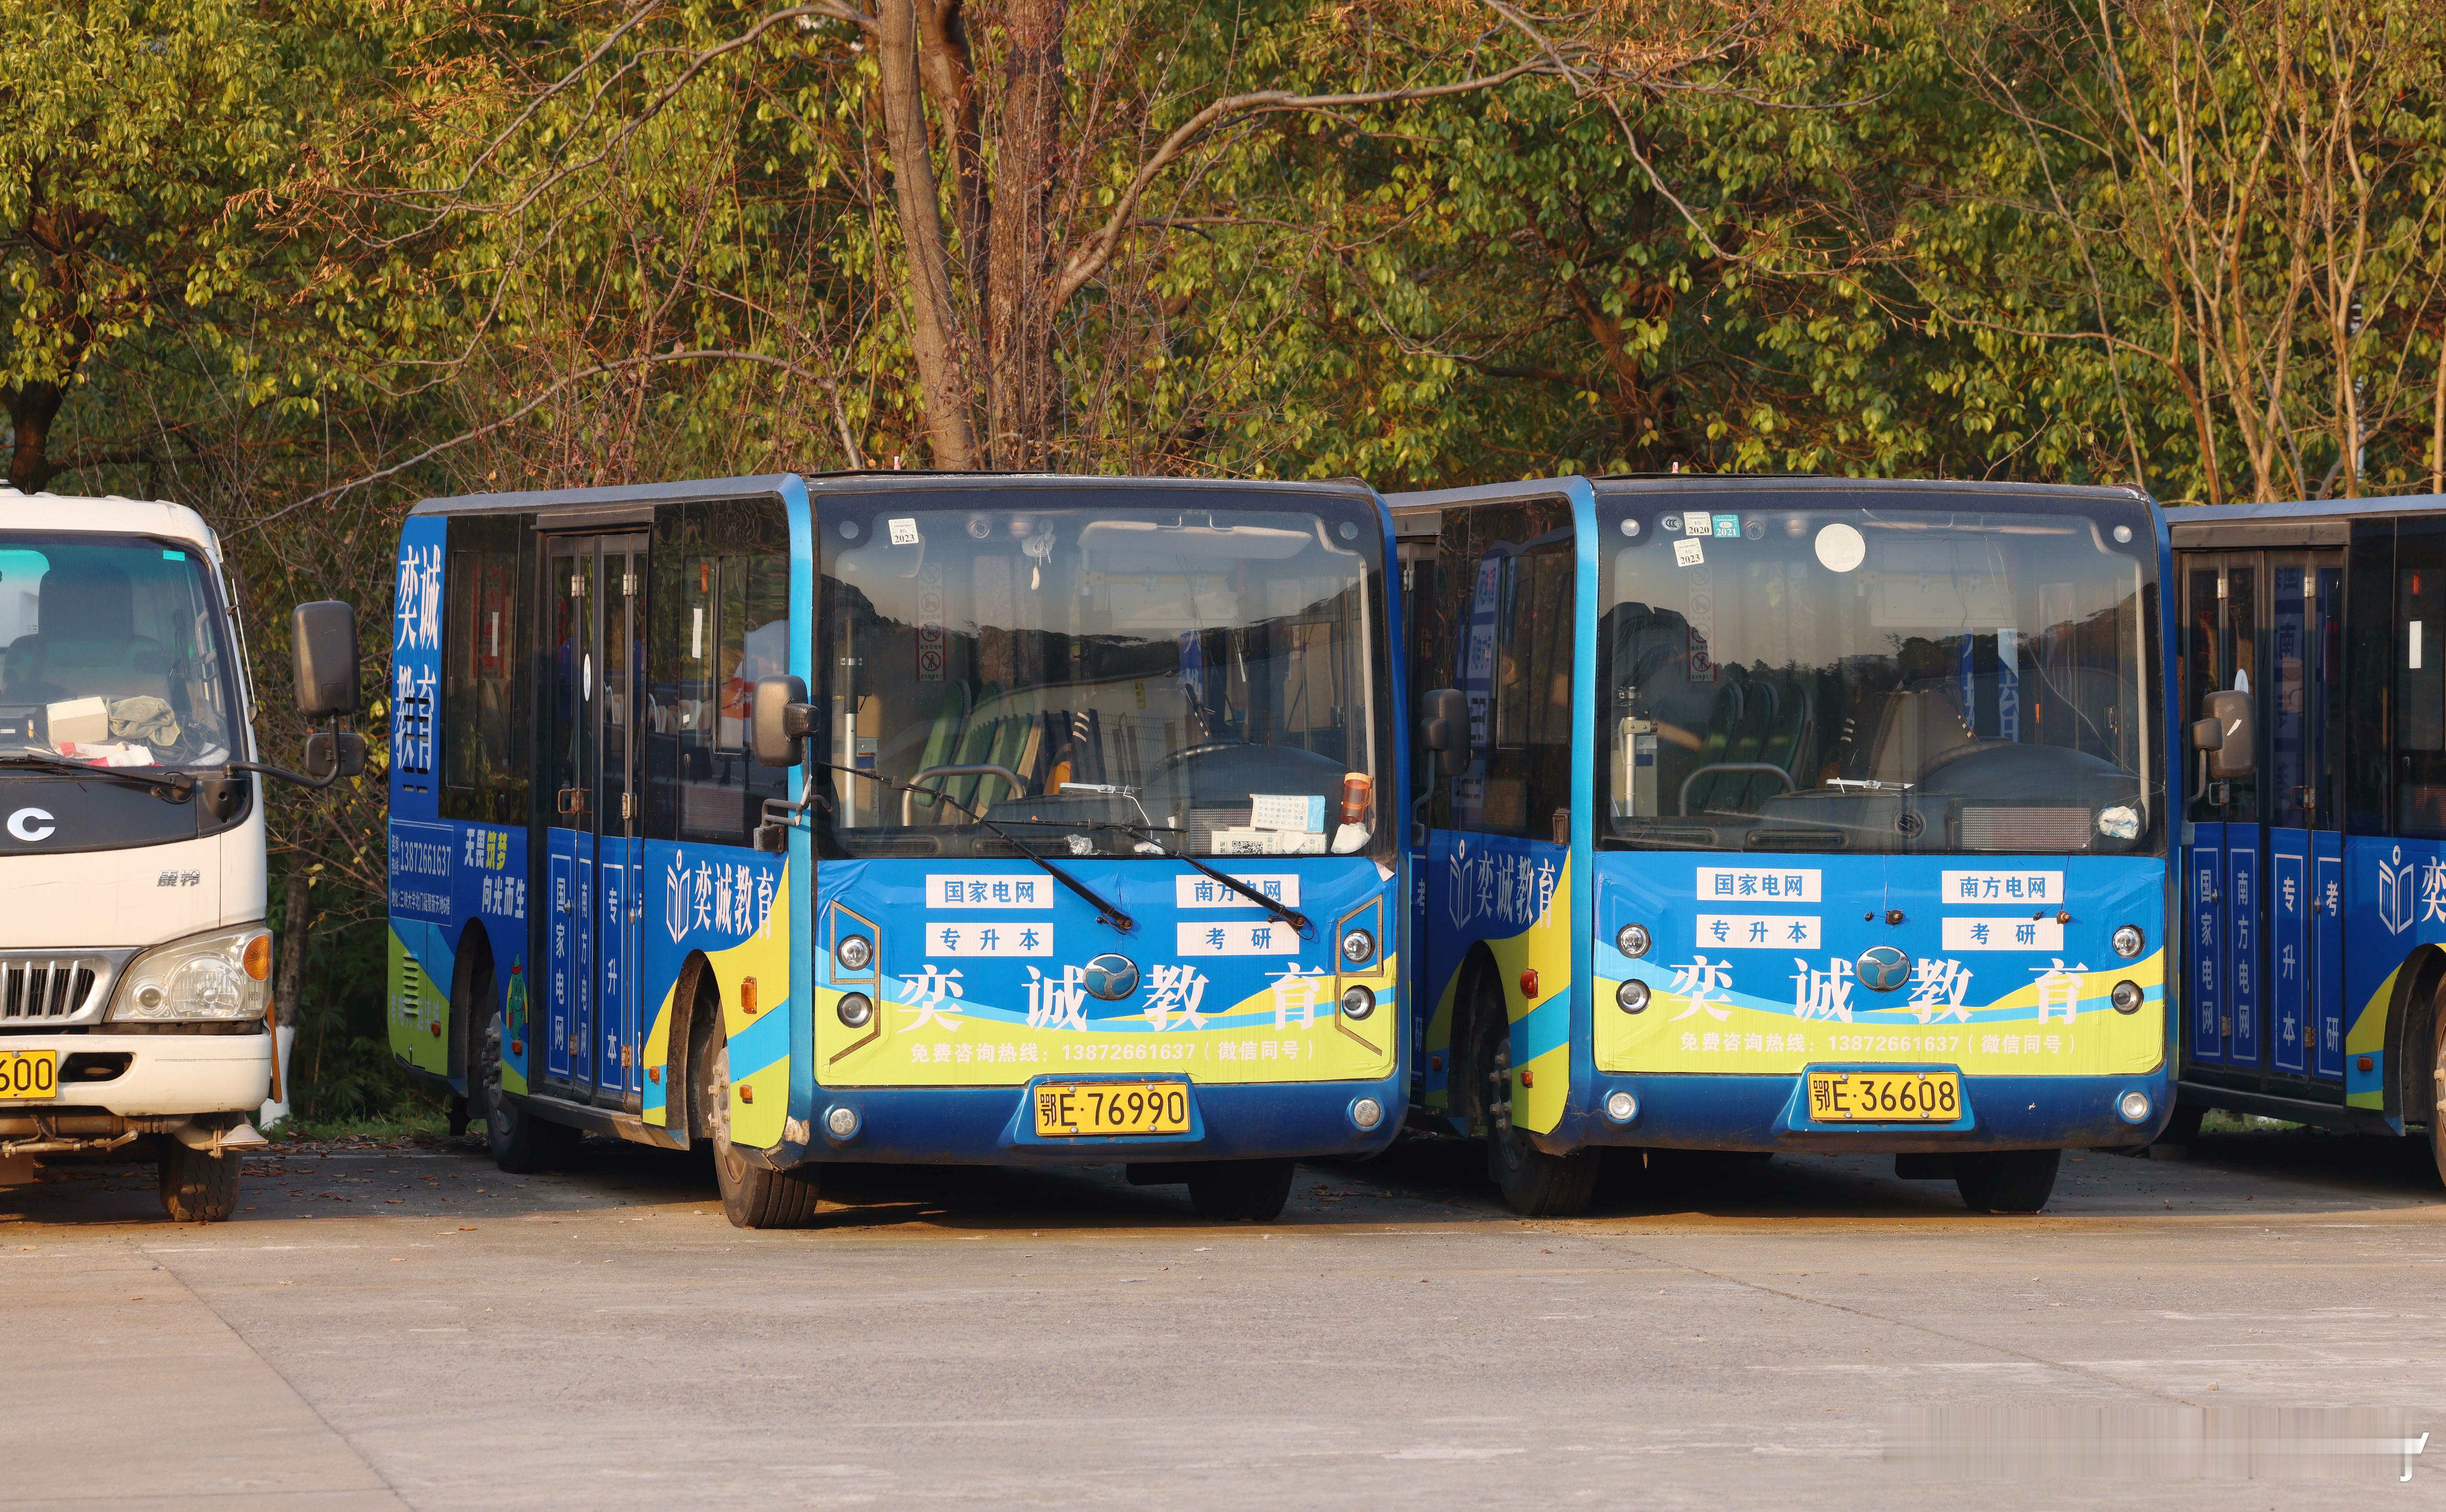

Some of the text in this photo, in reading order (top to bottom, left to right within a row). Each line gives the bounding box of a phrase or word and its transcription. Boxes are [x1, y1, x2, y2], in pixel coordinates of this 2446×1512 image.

[894, 534, 915, 543] 2023
[1716, 528, 1737, 536] 2021
[1680, 554, 1701, 565] 2023
[397, 544, 441, 651] 奕诚
[391, 834, 399, 853] 咨询
[400, 841, 451, 877] 13872661637
[464, 828, 508, 871] 无畏筑梦
[156, 869, 201, 887] 康铃
[944, 880, 1036, 904] 国家电网
[1475, 850, 1555, 930] 奕诚教育
[1714, 873, 1803, 897] 国家电网
[1959, 876, 2047, 899] 南方电网
[482, 874, 525, 919] 向光而生
[694, 860, 774, 940] 奕诚教育
[939, 927, 1040, 951] 专升本
[1205, 927, 1272, 950] 考研
[1710, 919, 1808, 944] 专升本
[1970, 922, 2036, 945] 考研
[554, 877, 565, 1051] 国家电网
[2200, 870, 2213, 1035] 国家电网
[2237, 870, 2250, 1039] 南方电网
[2282, 877, 2296, 1047] 专升本
[2325, 880, 2339, 1052] 考研
[607, 887, 617, 1066] 专升本
[1668, 955, 2089, 1026] 奕诚教育
[897, 962, 1325, 1033] 奕诚教育
[0, 1058, 52, 1092] 600
